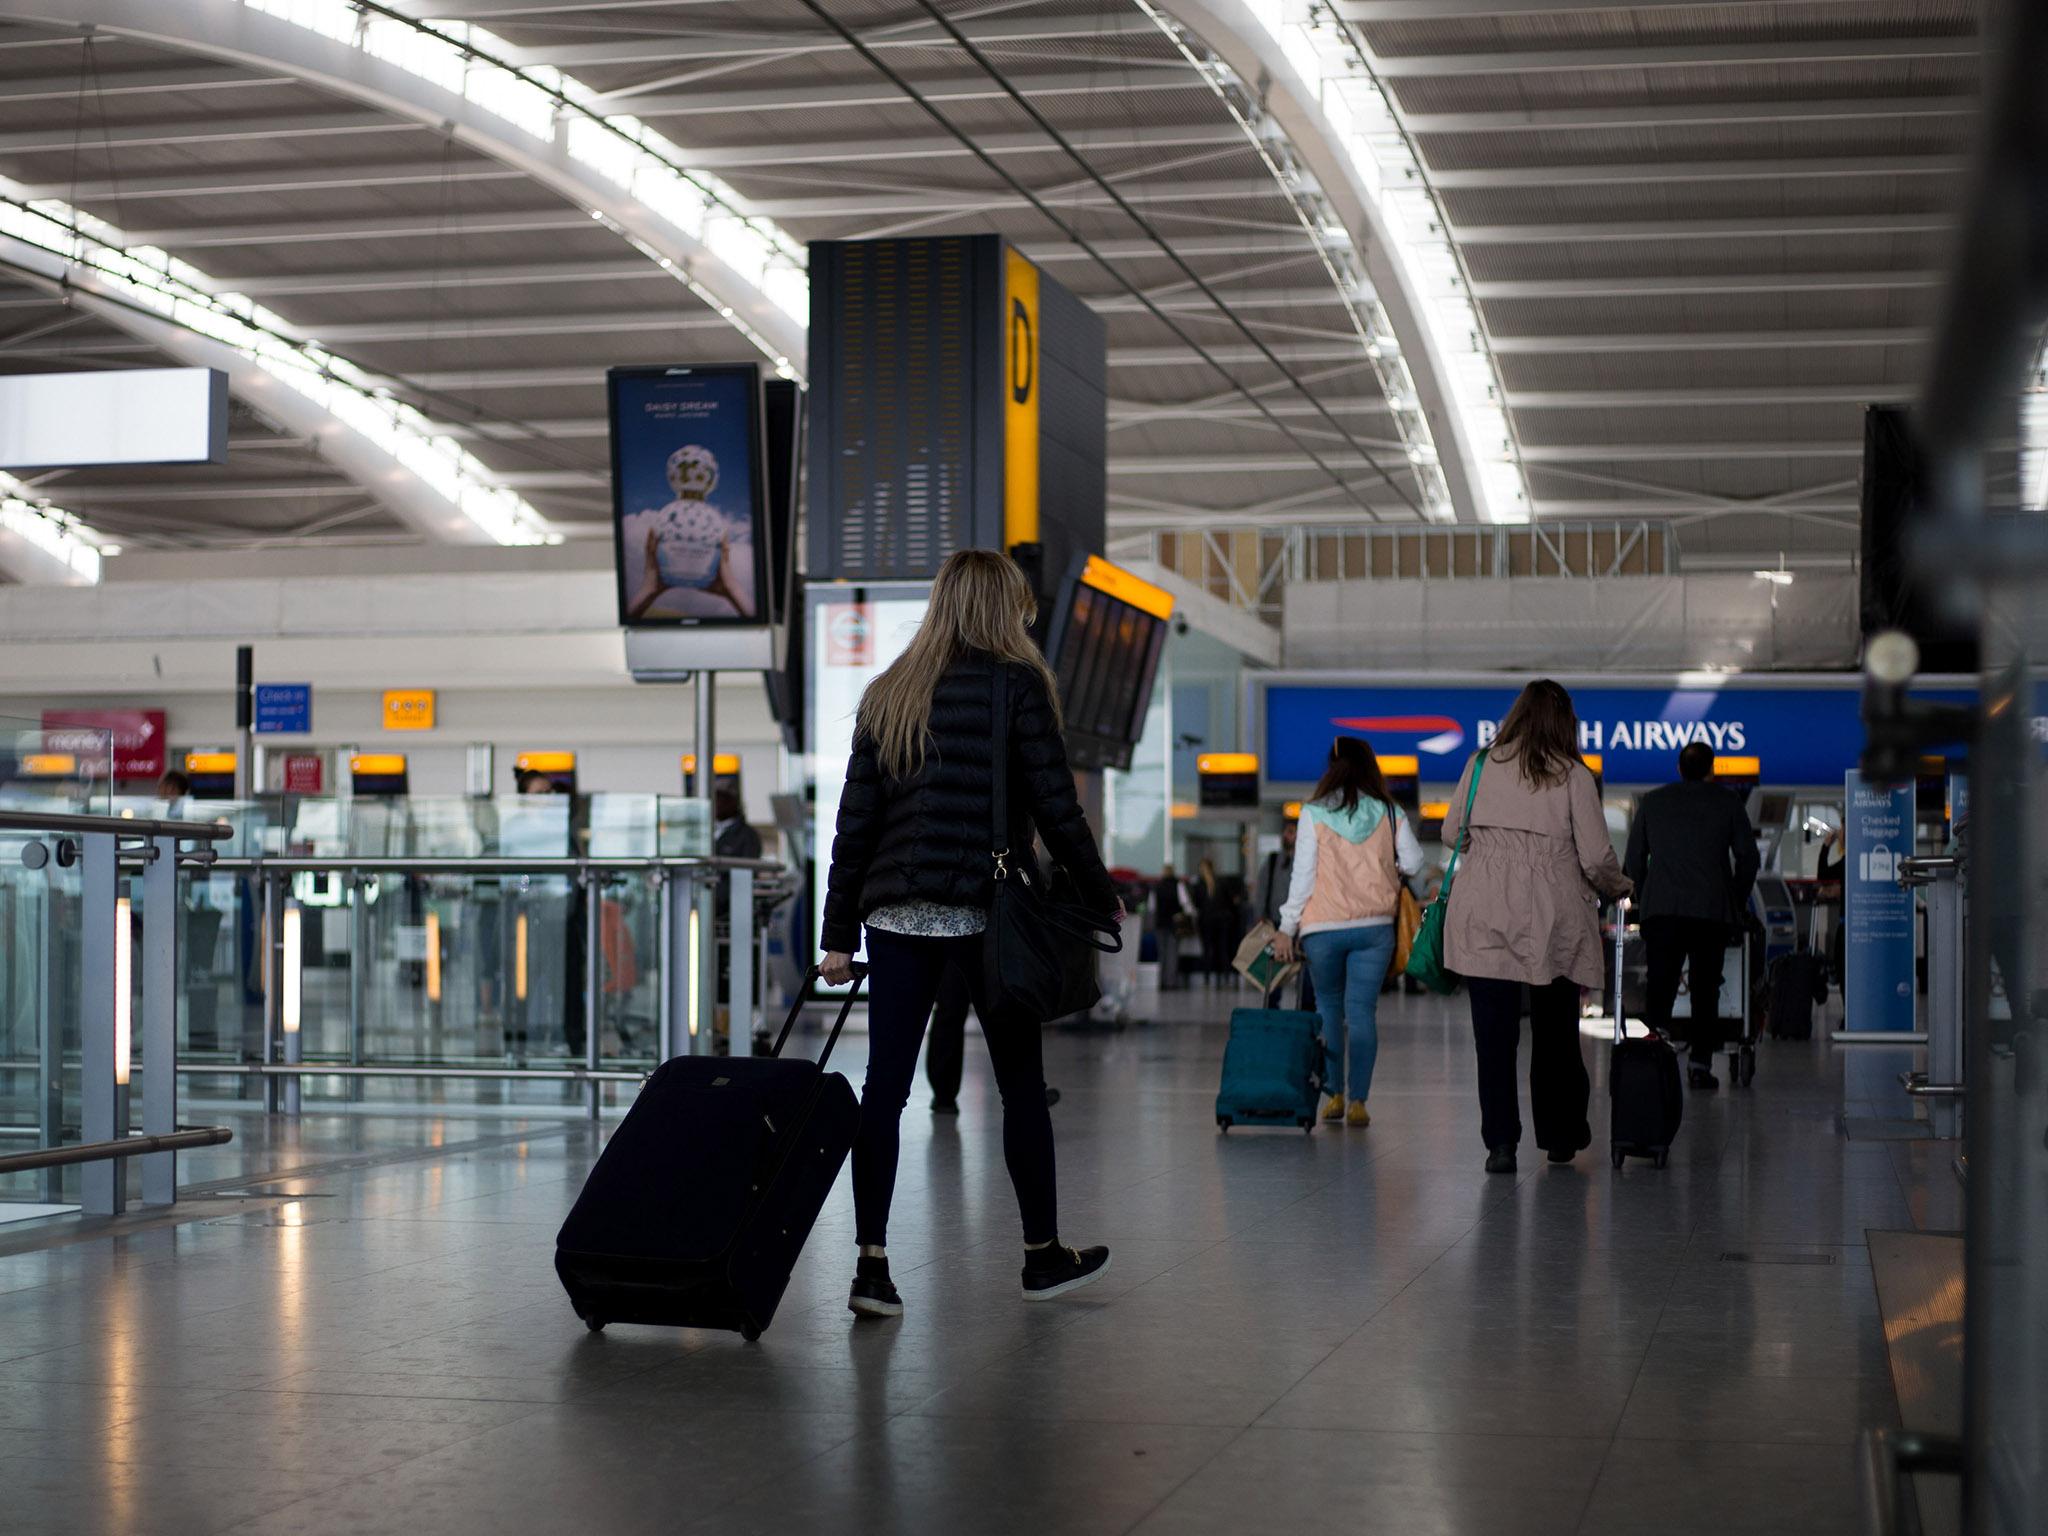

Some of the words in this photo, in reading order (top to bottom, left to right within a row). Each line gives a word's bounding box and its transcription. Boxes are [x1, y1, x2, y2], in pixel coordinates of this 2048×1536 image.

[1013, 297, 1032, 405] D
[1609, 720, 1747, 750] AIRWAYS
[1861, 815, 1900, 825] Checked
